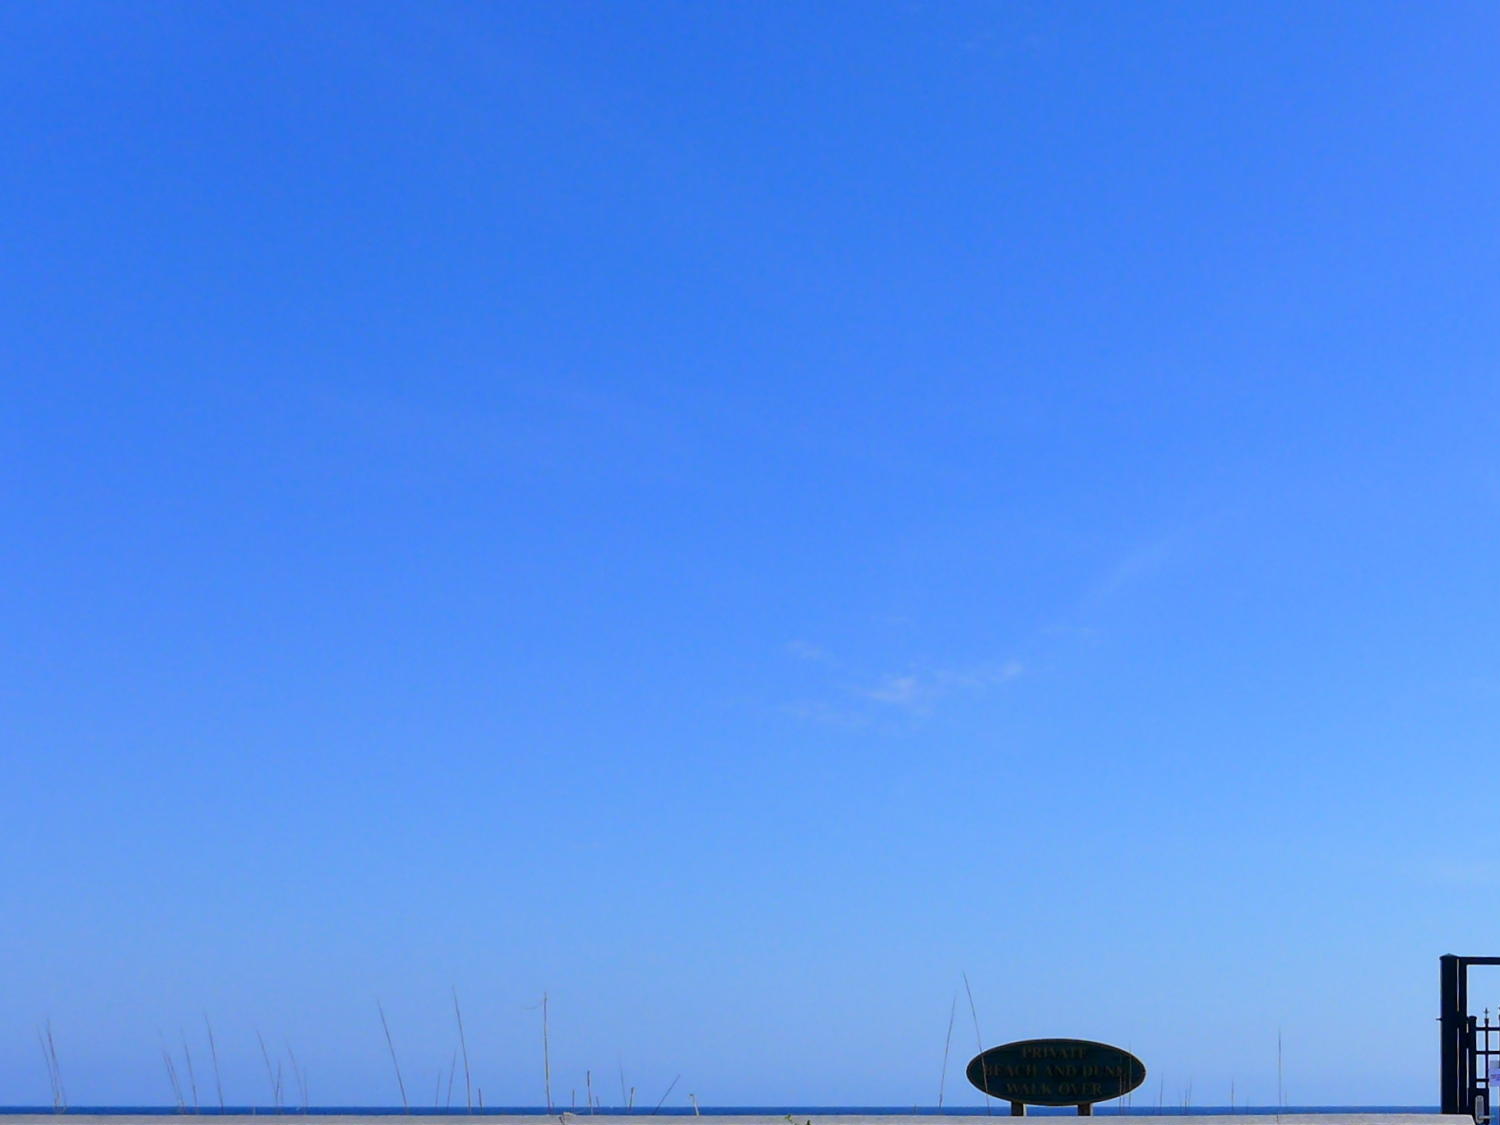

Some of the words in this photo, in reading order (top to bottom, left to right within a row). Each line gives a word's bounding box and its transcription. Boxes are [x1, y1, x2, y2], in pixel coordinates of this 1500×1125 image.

[1022, 1046, 1088, 1058] PRIVATE
[985, 1063, 1037, 1077] BEACH
[1046, 1063, 1077, 1077] AND
[1006, 1082, 1052, 1095] WALK
[1058, 1082, 1103, 1095] OVER
